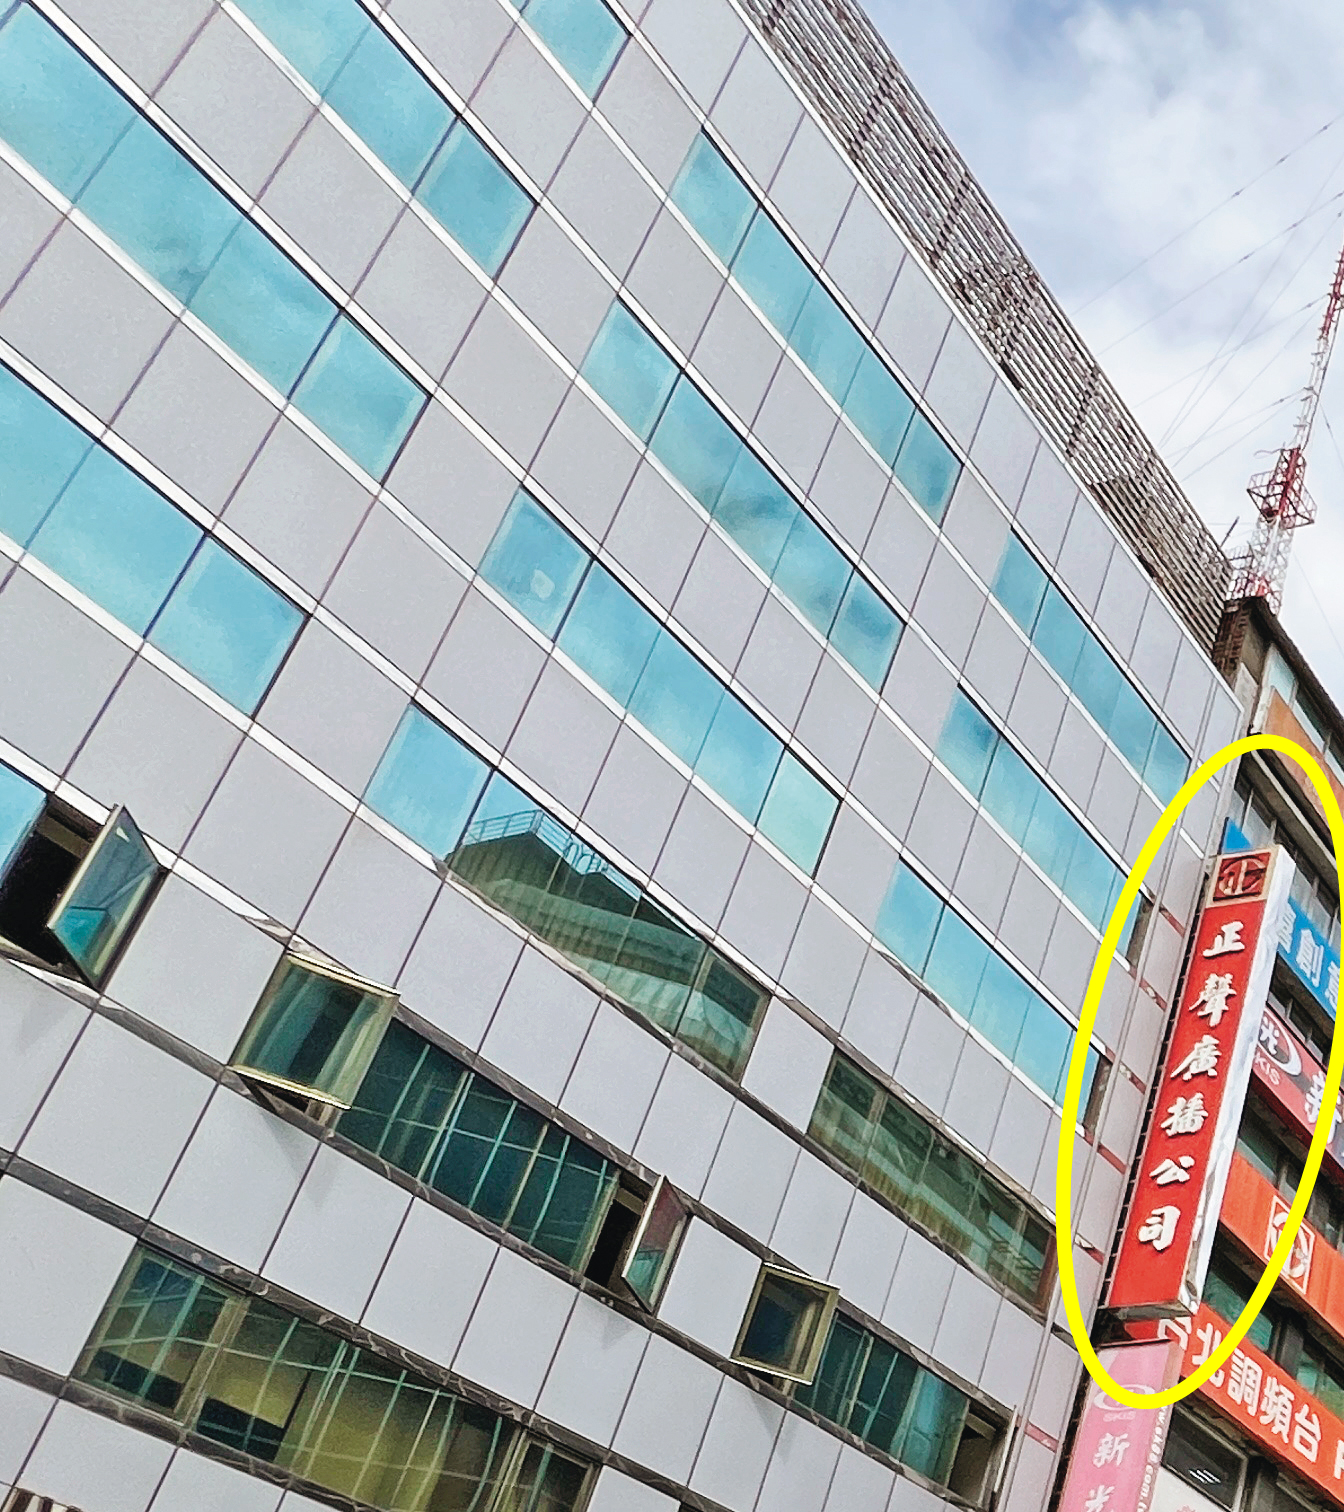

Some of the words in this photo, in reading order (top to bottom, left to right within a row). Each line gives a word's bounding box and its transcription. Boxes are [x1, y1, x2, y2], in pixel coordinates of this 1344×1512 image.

[1138, 920, 1245, 1251] 正聲廣播公司
[1255, 1053, 1281, 1085] KIS
